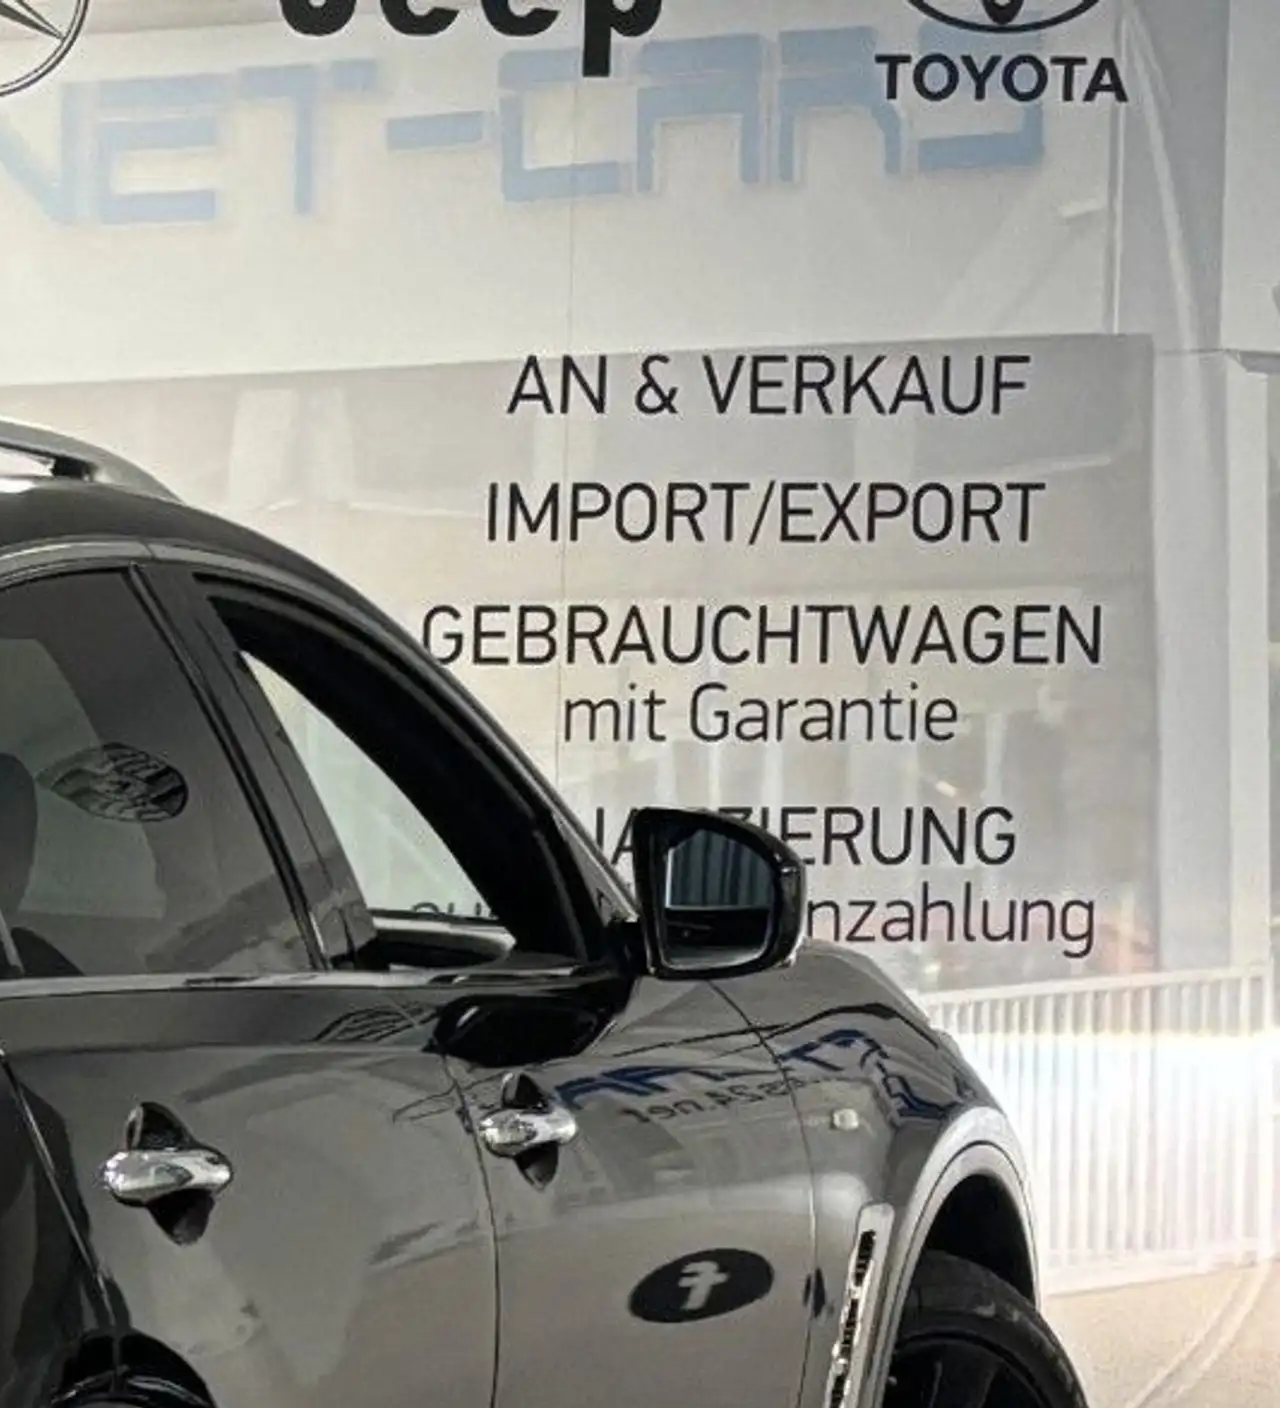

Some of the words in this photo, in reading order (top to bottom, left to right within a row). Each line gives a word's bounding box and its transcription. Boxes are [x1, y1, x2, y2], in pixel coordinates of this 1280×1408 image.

[874, 52, 1130, 103] TOYOTA
[507, 355, 608, 415] AN
[635, 354, 679, 416] &
[702, 355, 1032, 416] VERKAUF
[487, 481, 1046, 546] IMPORT/EXPORT
[422, 604, 1103, 665] GEBRAUCHTWAGEN
[564, 683, 667, 742] mit
[690, 682, 958, 742] Garantie
